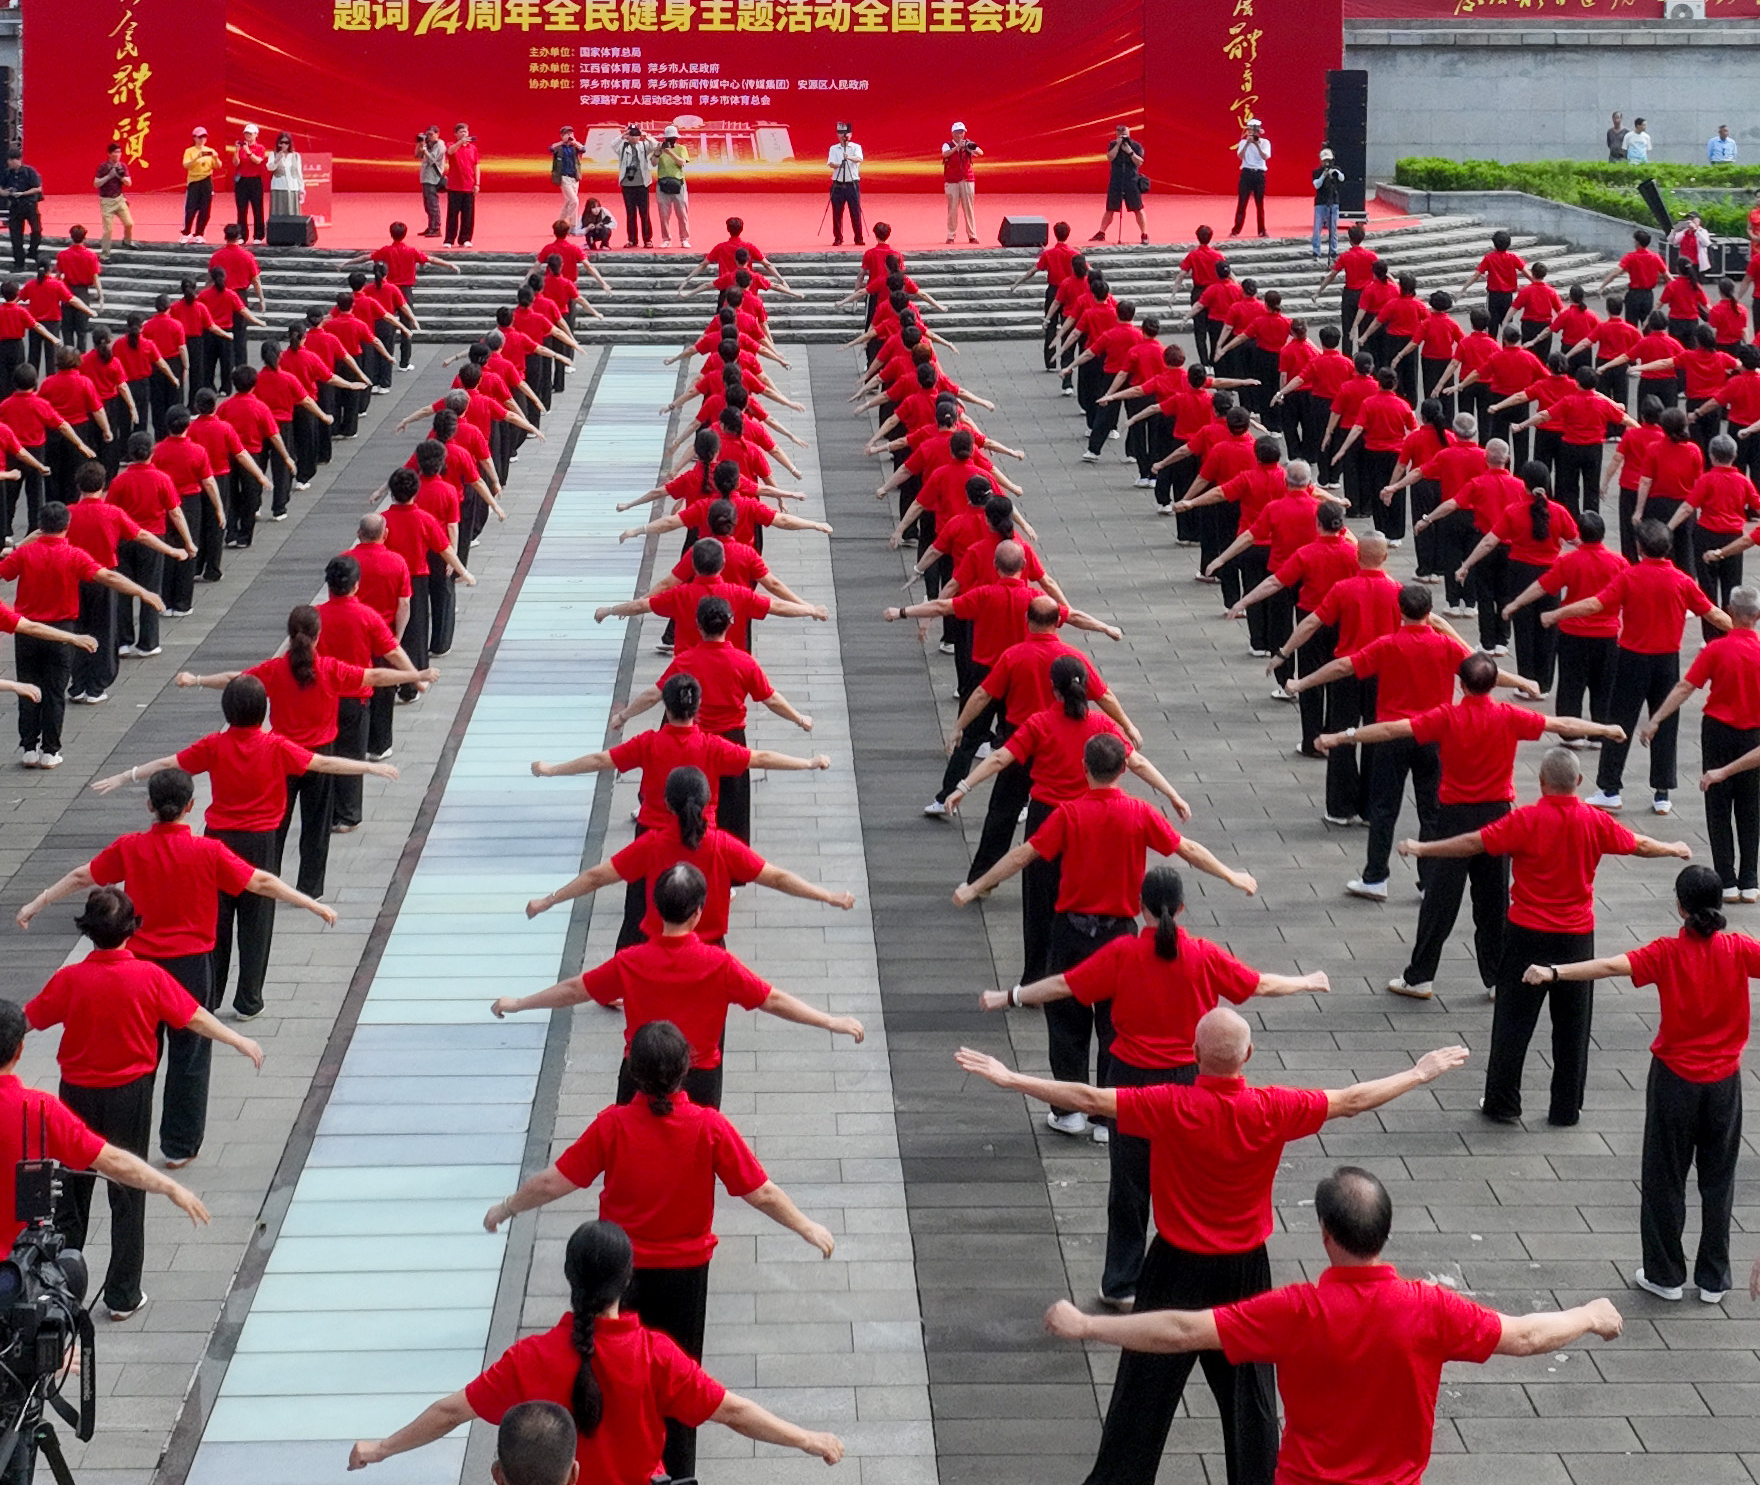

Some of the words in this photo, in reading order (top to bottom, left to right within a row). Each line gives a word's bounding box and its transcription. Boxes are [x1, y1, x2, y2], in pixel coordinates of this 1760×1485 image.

[580, 46, 641, 58] 国家体育总局
[580, 62, 641, 74] 江西省体育局
[648, 62, 720, 74] 萍乡市人民政府
[580, 78, 641, 90] 萍乡市体育局
[798, 78, 870, 91] 安源区人民政府
[700, 94, 771, 106] 萍乡市体育总会
[84, 1347, 92, 1401] Panasonic
